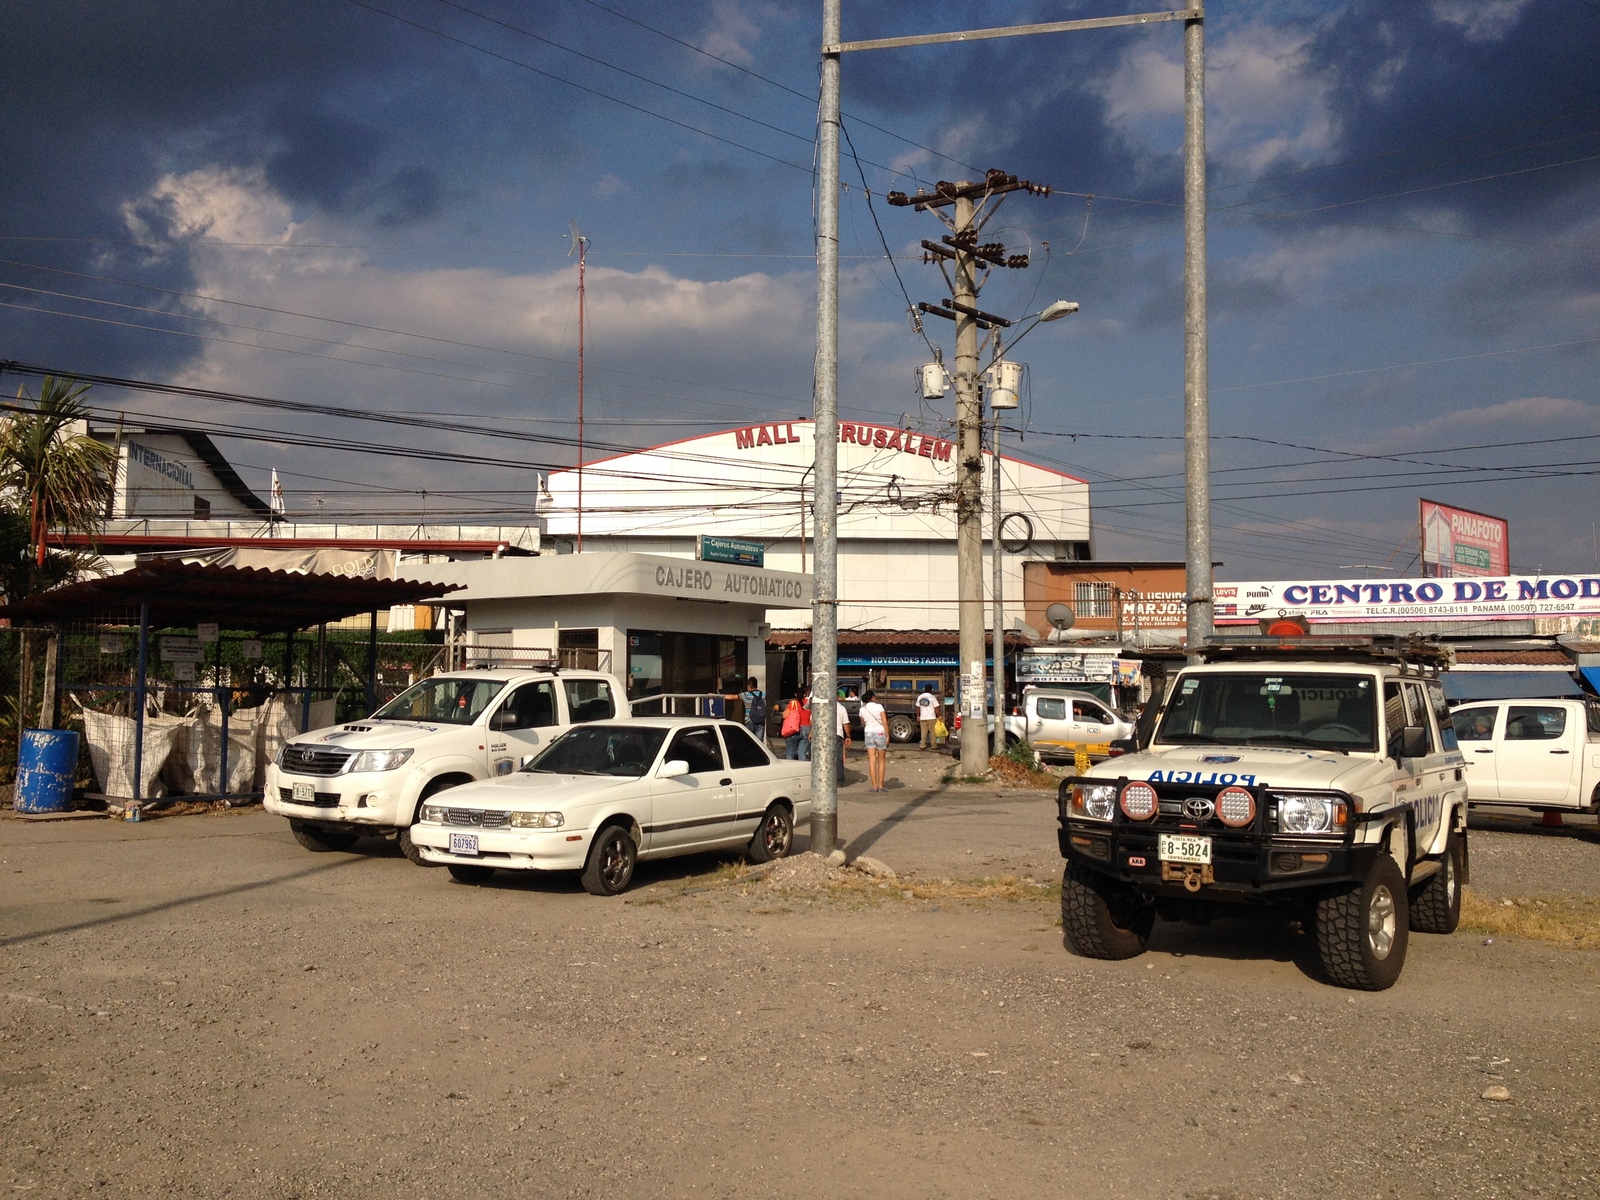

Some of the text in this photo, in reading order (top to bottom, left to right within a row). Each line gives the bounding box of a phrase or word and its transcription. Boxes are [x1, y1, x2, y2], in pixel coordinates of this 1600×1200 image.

[735, 423, 952, 462] MALL RUSALEM
[129, 440, 194, 490] INTERNACIONAL
[1452, 514, 1502, 542] PANAFOTO
[711, 539, 730, 548] Cajeros
[332, 557, 374, 575] GOLD
[655, 565, 802, 598] CAJERO AUTOMATICO
[1283, 578, 1600, 606] CENTRO DE MOD
[1428, 605, 1469, 613] 8743-8118
[1508, 604, 1538, 613] (00507)
[1540, 603, 1575, 611] 727-6547
[871, 656, 919, 664] NOVEDADES
[453, 838, 477, 850] 607962
[1167, 841, 1208, 857] 8-5824
